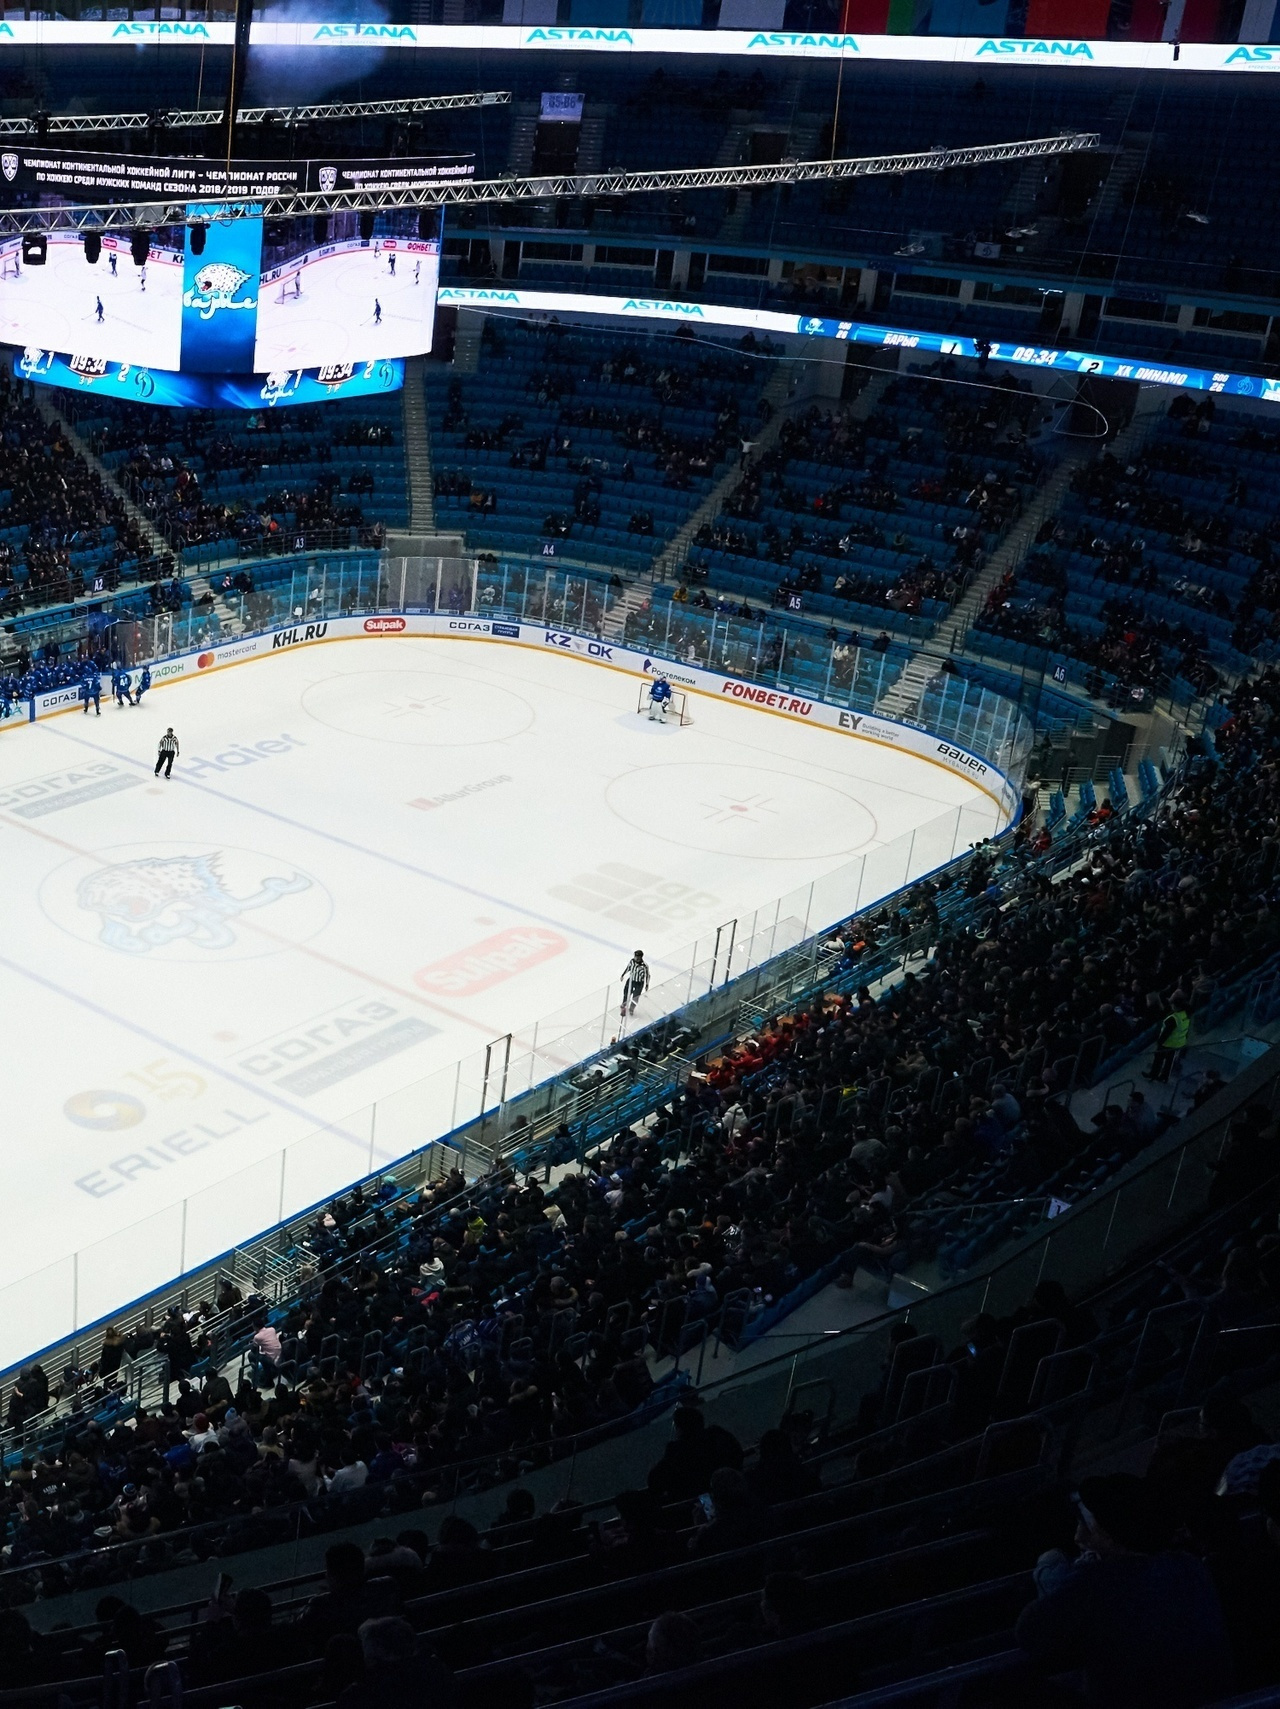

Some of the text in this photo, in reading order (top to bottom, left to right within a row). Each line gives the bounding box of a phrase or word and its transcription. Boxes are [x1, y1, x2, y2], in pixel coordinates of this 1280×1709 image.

[112, 22, 210, 38] ASTANA
[313, 23, 417, 41] ASTANA
[526, 28, 634, 45] ASTANA
[747, 33, 860, 52] ASTANA
[976, 40, 1093, 59] ASTANA
[24, 158, 60, 170] ЧЕМПИОНАТ
[62, 161, 125, 174] КОНТИНЕНТАЛЬНОЙ
[127, 164, 170, 178] ХОККЕЙНОЙ
[171, 169, 195, 179] ЛИГИ
[206, 170, 264, 181] ЧЕМПИОНАТ
[266, 172, 297, 181] РОССИИ
[36, 173, 45, 181] ПО
[46, 174, 72, 184] ХОККЕЮ
[74, 176, 94, 186] СРЕДИ
[96, 177, 130, 189] МУЖСКИХ
[131, 180, 162, 192] КОМАНД
[163, 183, 196, 193] СЕЗОНА
[198, 184, 248, 194] 2018/2019
[407, 242, 432, 251] ФОНБЕТ
[439, 288, 520, 304] ASTANA
[622, 299, 705, 317] ASTANA
[883, 333, 919, 348] БАРЫС
[47, 351, 55, 368] 1
[70, 354, 107, 374] 09:34
[1012, 347, 1059, 365] 09:34
[117, 364, 130, 382] 2
[294, 369, 303, 388] 1
[318, 362, 353, 380] 09:34
[363, 360, 376, 379] 2
[1086, 362, 1100, 374] 2
[1113, 365, 1133, 377] ХК
[294, 537, 305, 548] A3
[543, 545, 554, 555] A4
[94, 578, 103, 591] A2
[789, 597, 801, 609] A5
[366, 621, 404, 632] Sulpak
[449, 621, 490, 633] СОГАЗ
[272, 623, 328, 649] KHL.RU
[217, 643, 257, 660] mastercard
[545, 632, 571, 648] KZ
[588, 643, 613, 659] OK
[135, 663, 184, 685] МГАФОН
[651, 667, 696, 685] Ростелеком
[1054, 667, 1065, 681] A6
[43, 692, 77, 708] СОГАЗ
[722, 680, 813, 716] FONBET.RU
[838, 711, 863, 731] EY
[170, 733, 307, 779] Haier
[424, 932, 555, 991] Sulpak
[238, 1000, 398, 1077] СОГАЗ
[74, 1108, 270, 1199] ERIELL
